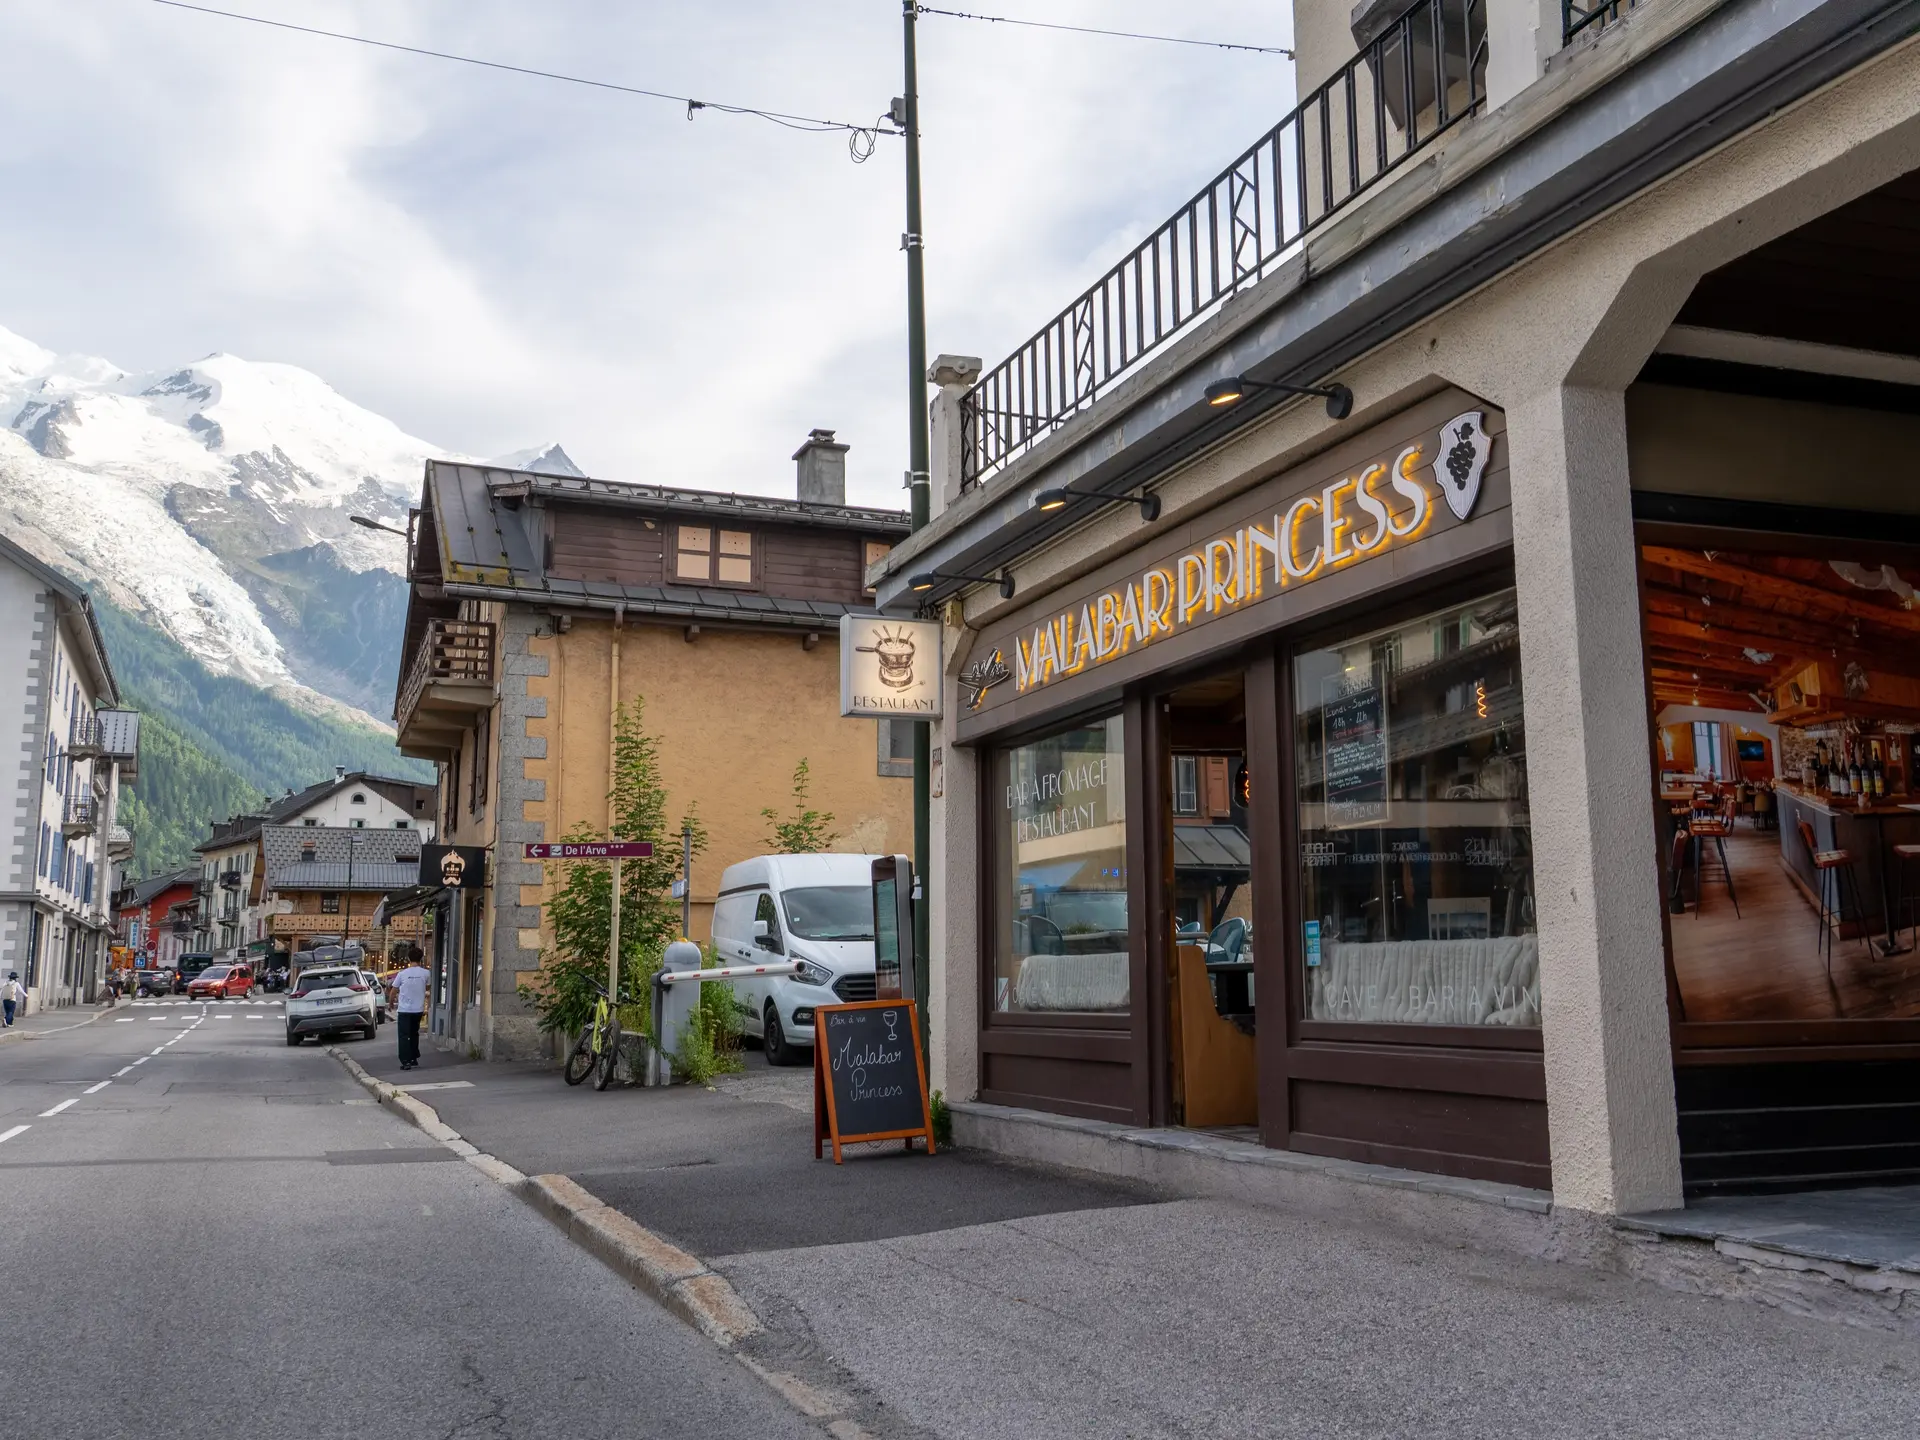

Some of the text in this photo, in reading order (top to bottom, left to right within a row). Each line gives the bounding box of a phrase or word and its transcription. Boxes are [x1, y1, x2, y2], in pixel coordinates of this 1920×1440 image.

[1015, 446, 1429, 691] MALABAR PRINCESS
[853, 695, 936, 711] RESTAURANT
[1006, 758, 1109, 809] BAR À FROMAGE
[1017, 801, 1097, 843] RESTAURANT
[565, 845, 607, 855] De l'Arve
[1325, 984, 1379, 1009] CAVE
[1409, 985, 1454, 1010] BAR
[1493, 986, 1540, 1013] VIN
[830, 1014, 866, 1027] Bar à vin
[833, 1037, 902, 1071] Malabar
[850, 1068, 903, 1102] Princess
